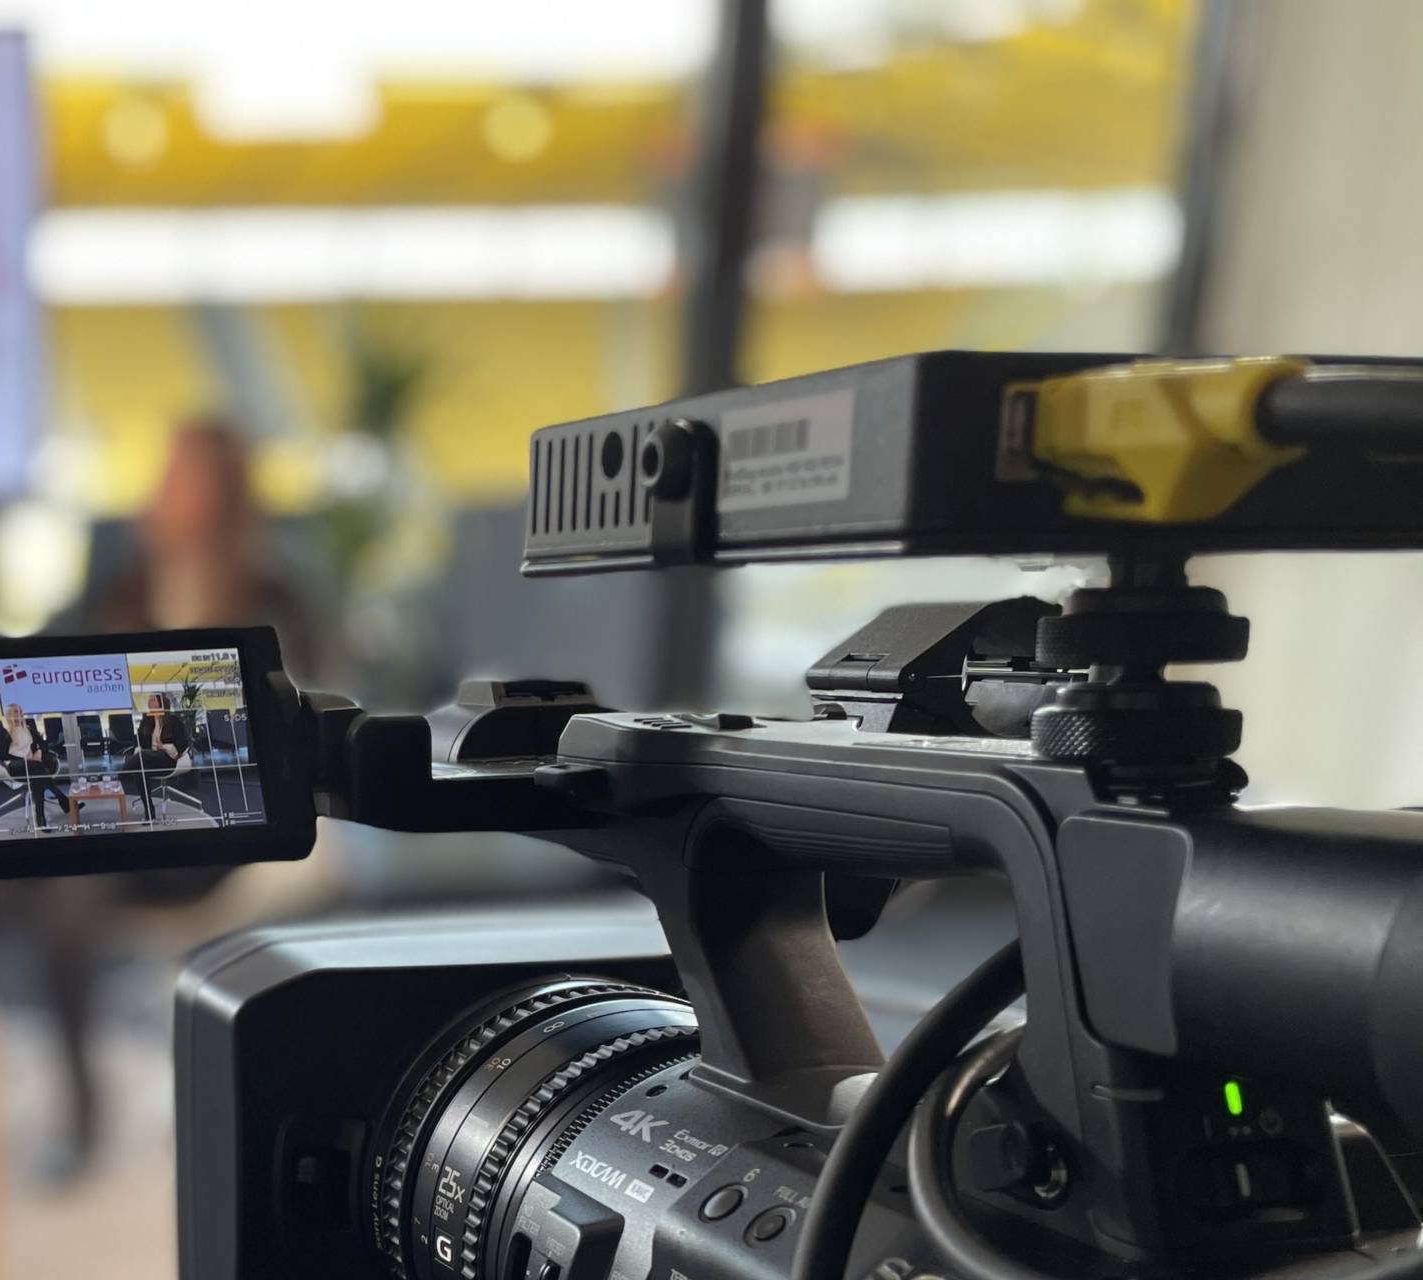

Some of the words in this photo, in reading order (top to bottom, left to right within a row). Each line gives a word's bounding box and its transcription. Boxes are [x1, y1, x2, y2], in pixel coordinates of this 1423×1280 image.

[32, 668, 123, 687] eurogress
[87, 683, 125, 693] aachen
[610, 1109, 670, 1143] 4K
[674, 1129, 713, 1151] Exmor
[569, 1151, 627, 1189] XDCAM
[743, 1168, 761, 1182] 6
[436, 1235, 452, 1262] G
